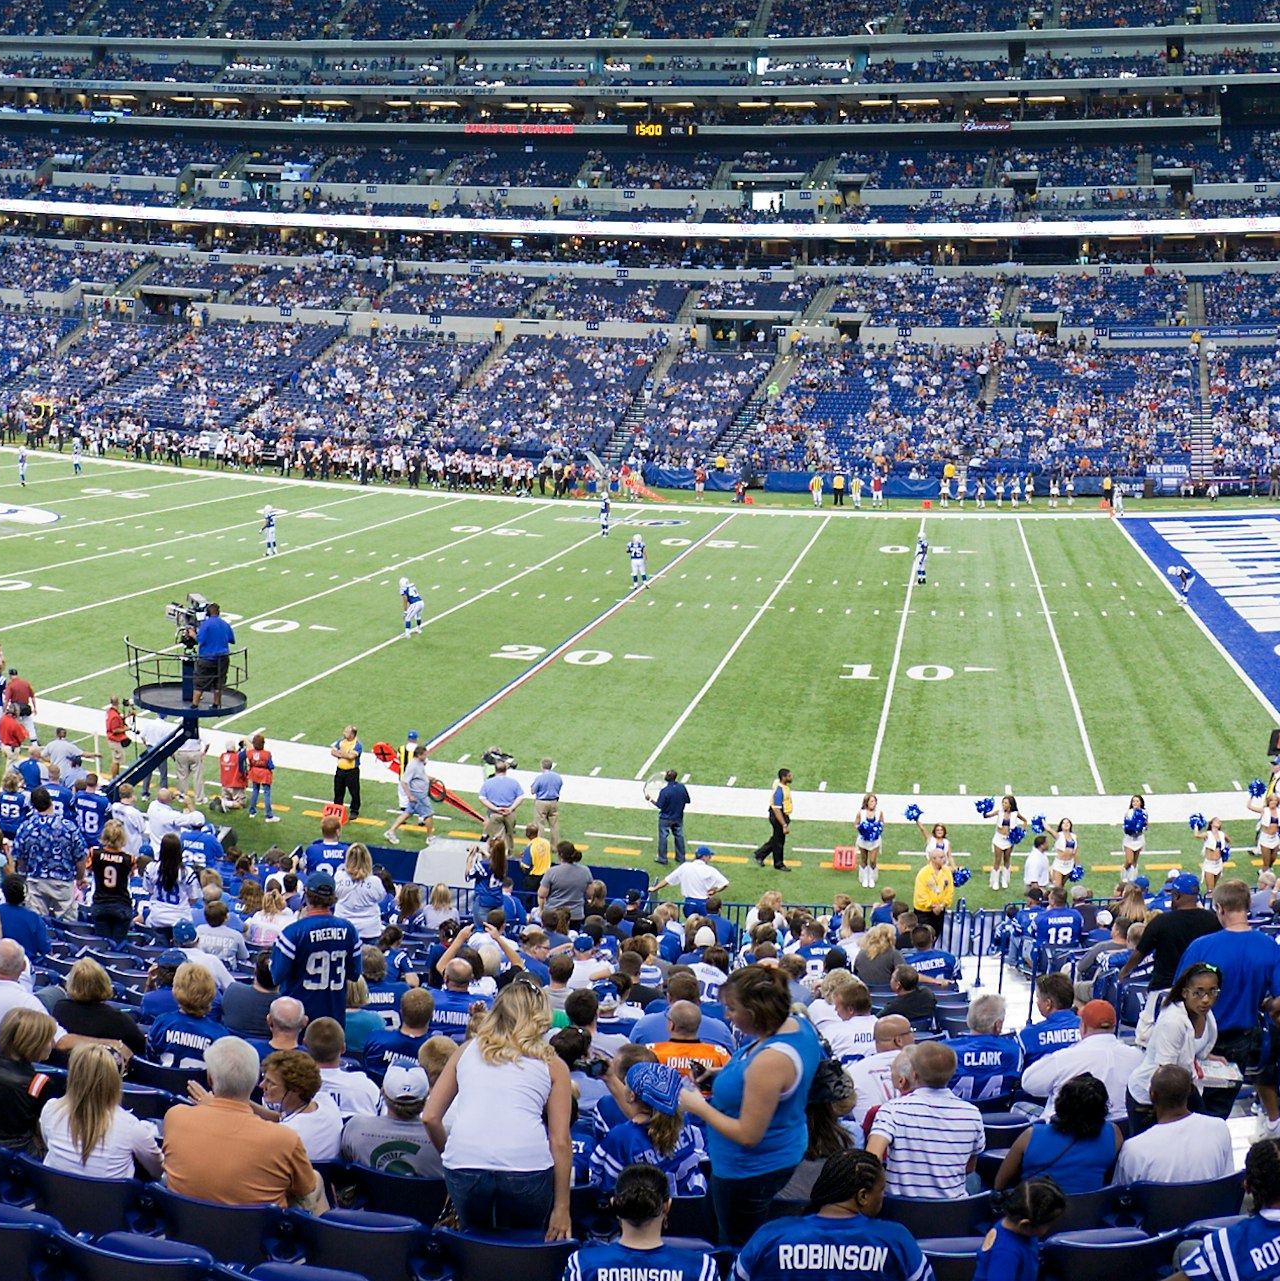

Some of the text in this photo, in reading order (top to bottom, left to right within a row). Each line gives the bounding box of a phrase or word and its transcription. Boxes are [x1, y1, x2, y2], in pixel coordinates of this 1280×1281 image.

[635, 124, 663, 136] 15:00
[962, 121, 1010, 131] Budweiser
[629, 548, 642, 558] 75
[490, 643, 613, 666] 20
[838, 663, 955, 682] 10
[77, 808, 100, 834] 18
[99, 853, 123, 862] PALMER
[838, 850, 853, 867] 10
[103, 865, 117, 889] 9
[309, 927, 348, 943] FREENEY
[1047, 926, 1073, 945] 18
[303, 949, 347, 992] 93
[432, 1009, 470, 1026] MANNIN
[166, 1028, 211, 1050] MANNING
[1039, 1027, 1081, 1045] SANDER
[963, 1051, 1002, 1066] CLARK
[778, 1244, 889, 1272] ROBINSON
